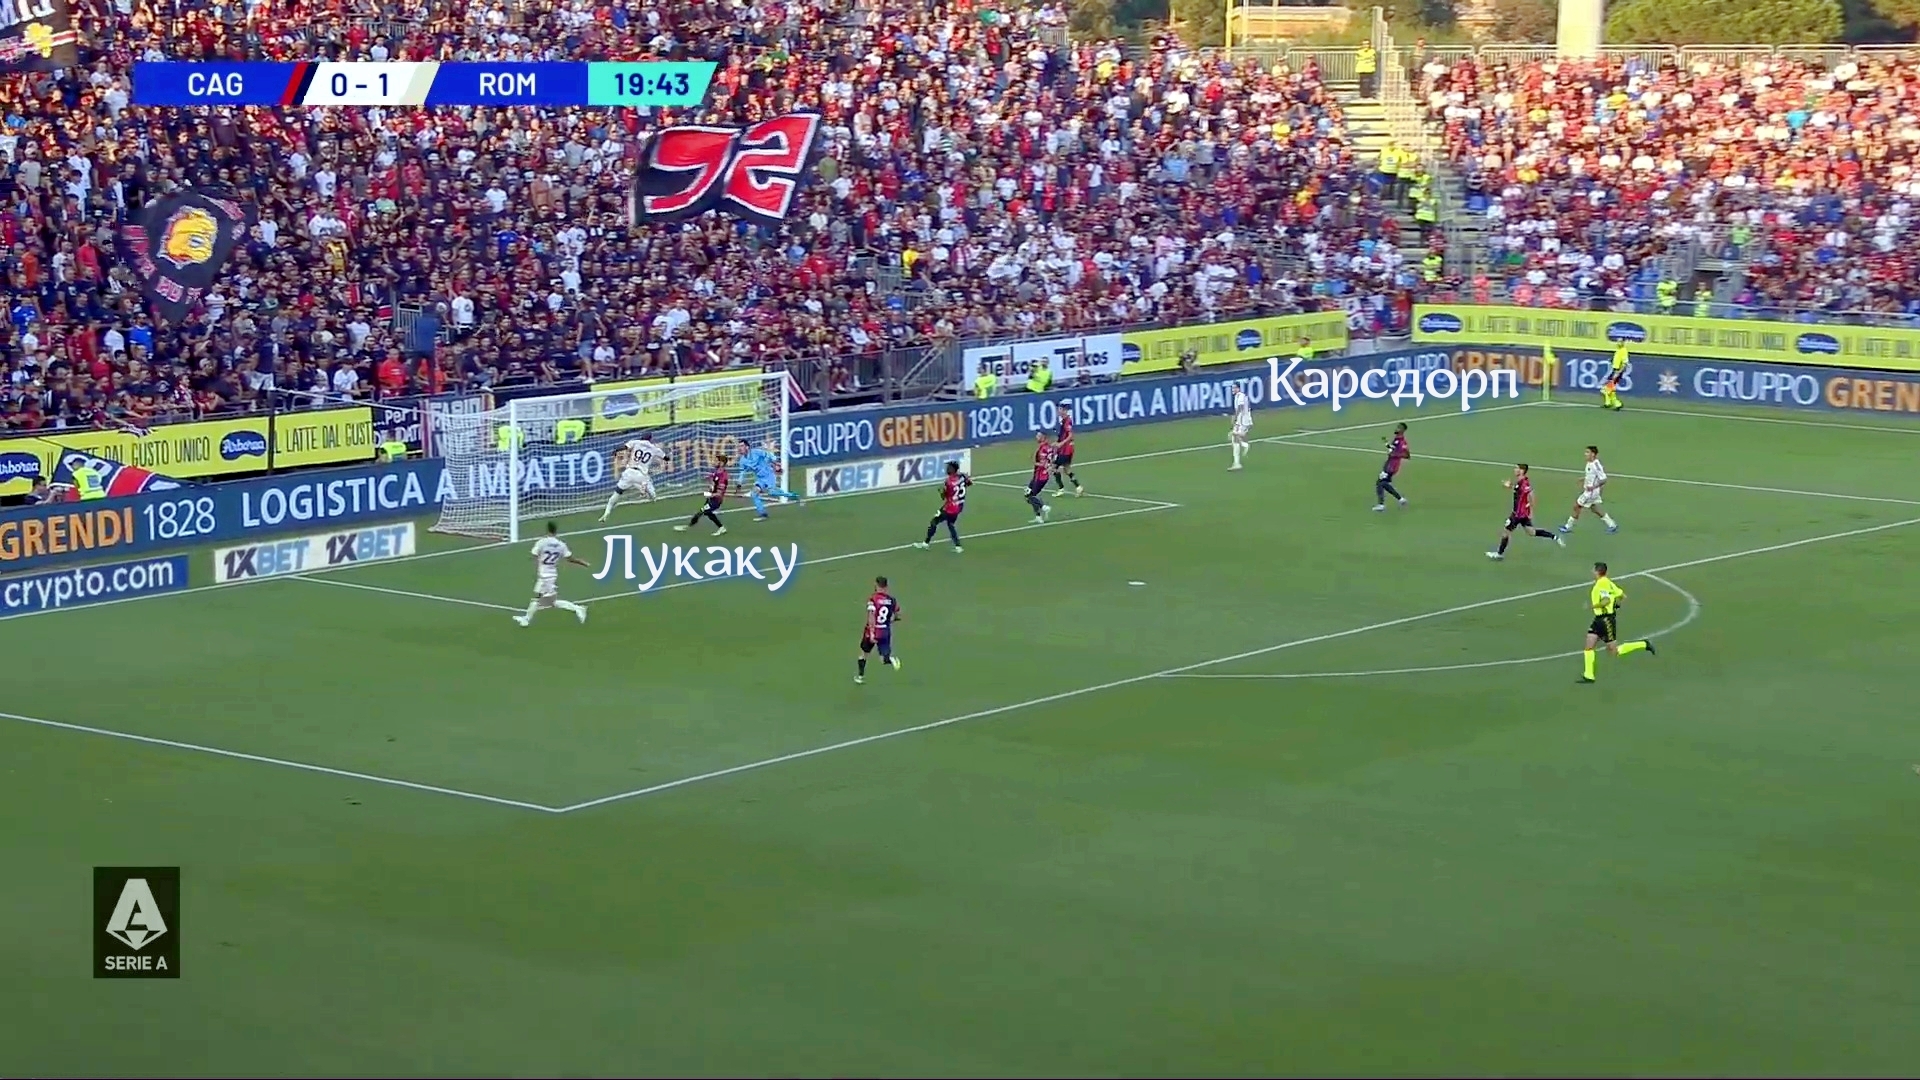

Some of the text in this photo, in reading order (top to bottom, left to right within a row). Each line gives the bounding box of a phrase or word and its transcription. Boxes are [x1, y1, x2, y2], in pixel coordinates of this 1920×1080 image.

[1694, 367, 1820, 405] GRUPPO
[1028, 388, 1145, 431] LOISTICA
[1150, 387, 1167, 416] A
[286, 426, 318, 453] LATTE
[322, 424, 341, 448] DAL
[788, 405, 1014, 459] GRUPPO GRENDI 1828
[133, 441, 169, 468] GUSTO
[174, 436, 211, 463] UNICO
[634, 449, 652, 464] 90
[814, 461, 884, 495] 1XBET
[242, 471, 426, 527] LOGISTICA
[435, 468, 458, 503] A
[0, 497, 216, 560] GRENDI 1828
[223, 525, 408, 580] 1XBET 1XBET
[543, 551, 560, 565] 22
[4, 560, 174, 608] crypto.com
[876, 606, 889, 623] 8
